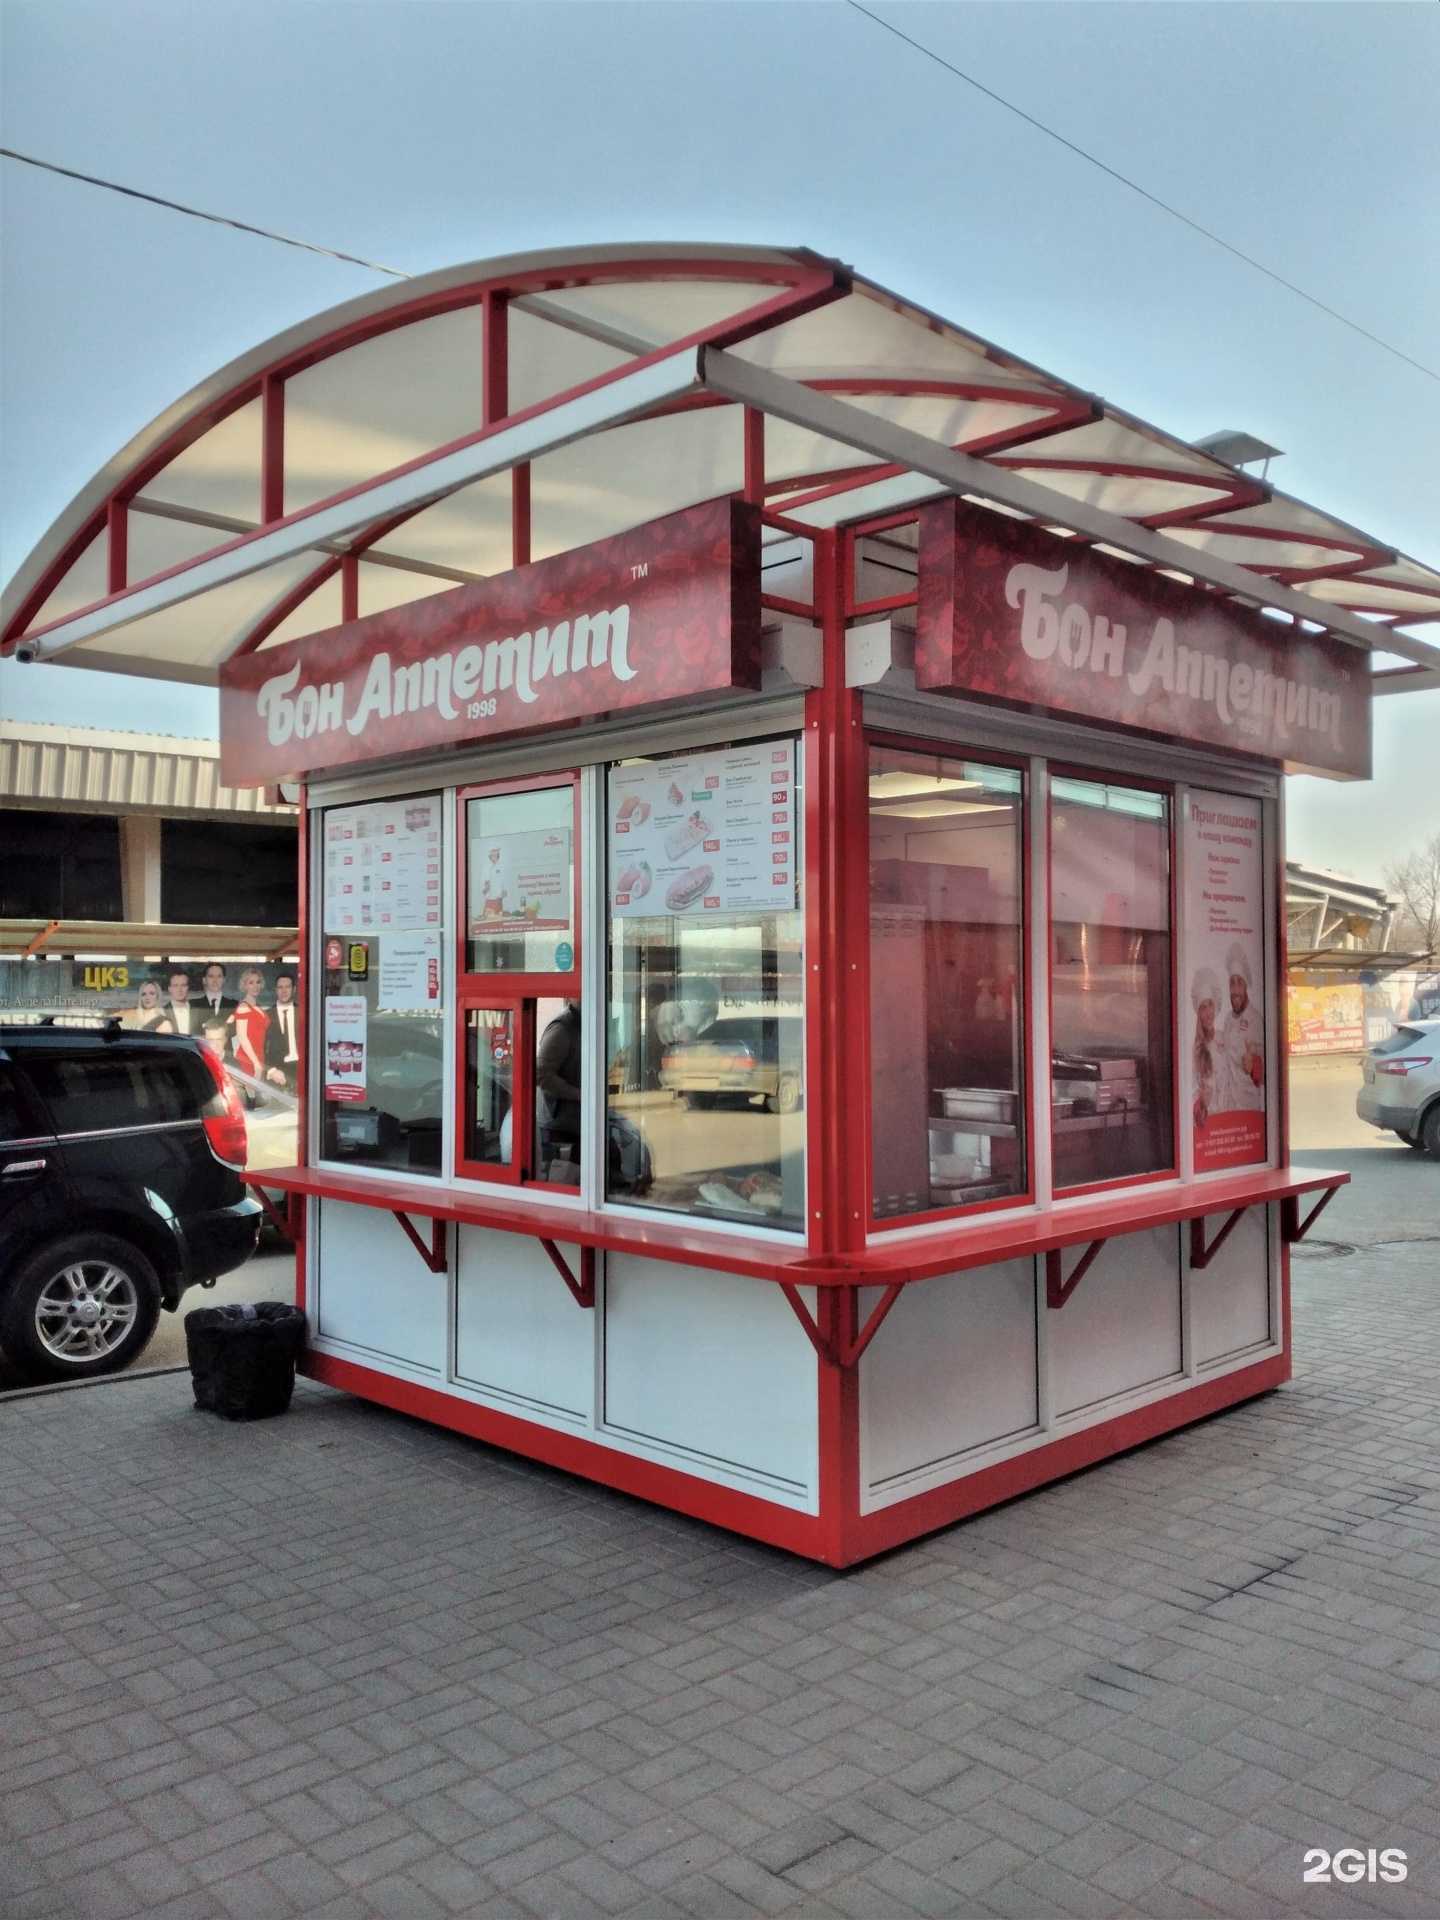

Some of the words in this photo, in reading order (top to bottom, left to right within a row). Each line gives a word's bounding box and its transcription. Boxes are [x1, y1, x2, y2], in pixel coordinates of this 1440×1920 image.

[630, 563, 649, 580] TM
[1004, 562, 1127, 677] Бон
[1128, 616, 1344, 752] Аппетит
[257, 658, 344, 746] Бон
[346, 603, 639, 736] Аппетит
[466, 697, 497, 720] 1998
[84, 966, 130, 992] ЦКЗ
